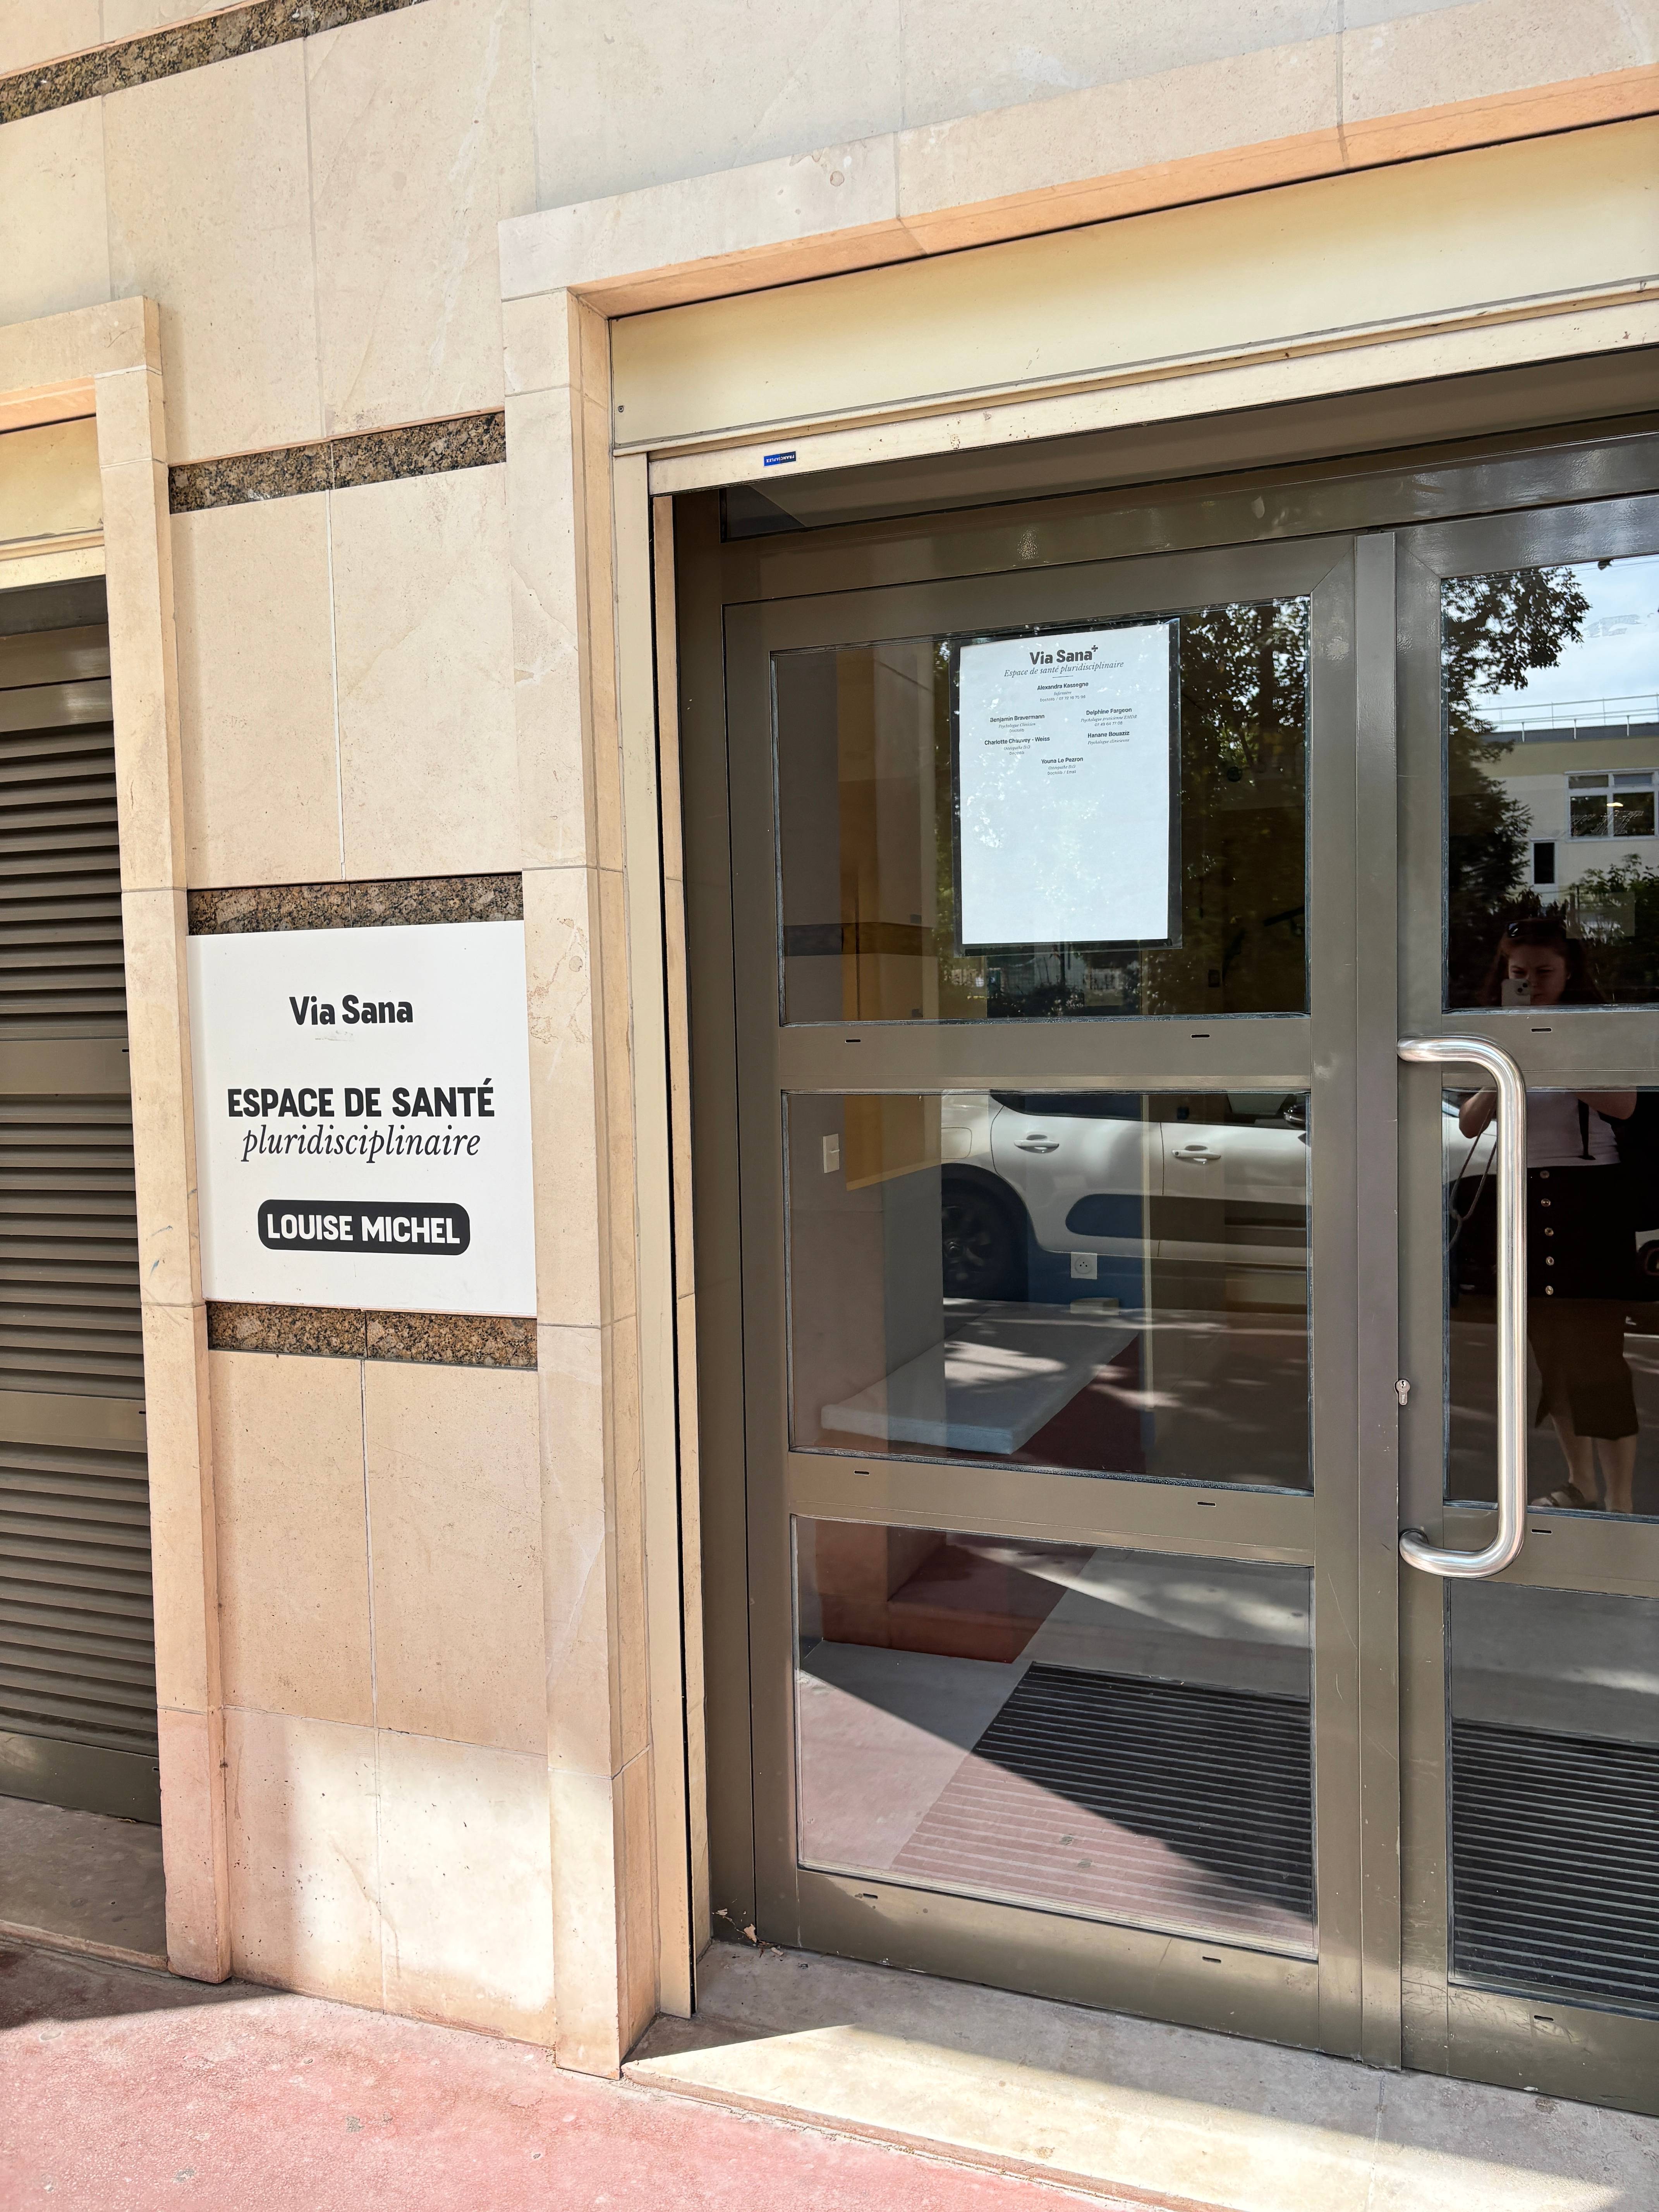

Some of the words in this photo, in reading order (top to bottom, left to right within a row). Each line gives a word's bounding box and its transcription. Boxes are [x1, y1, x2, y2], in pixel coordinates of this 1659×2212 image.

[766, 454, 795, 463] FRANCIAFLEX
[1004, 669, 1028, 678] Espace
[1040, 665, 1059, 674] santé
[1060, 661, 1124, 674] pluridisciplinaire
[1030, 651, 1053, 665] Via
[289, 996, 335, 1025] Via
[342, 994, 413, 1024] Sana
[227, 1088, 334, 1118] ESPACE
[344, 1087, 381, 1117] DE
[392, 1078, 495, 1117] SANTÉ
[241, 1124, 480, 1164] pluridisciplinaire
[267, 1213, 353, 1241] LOUISE
[361, 1216, 460, 1244] MICHEL
